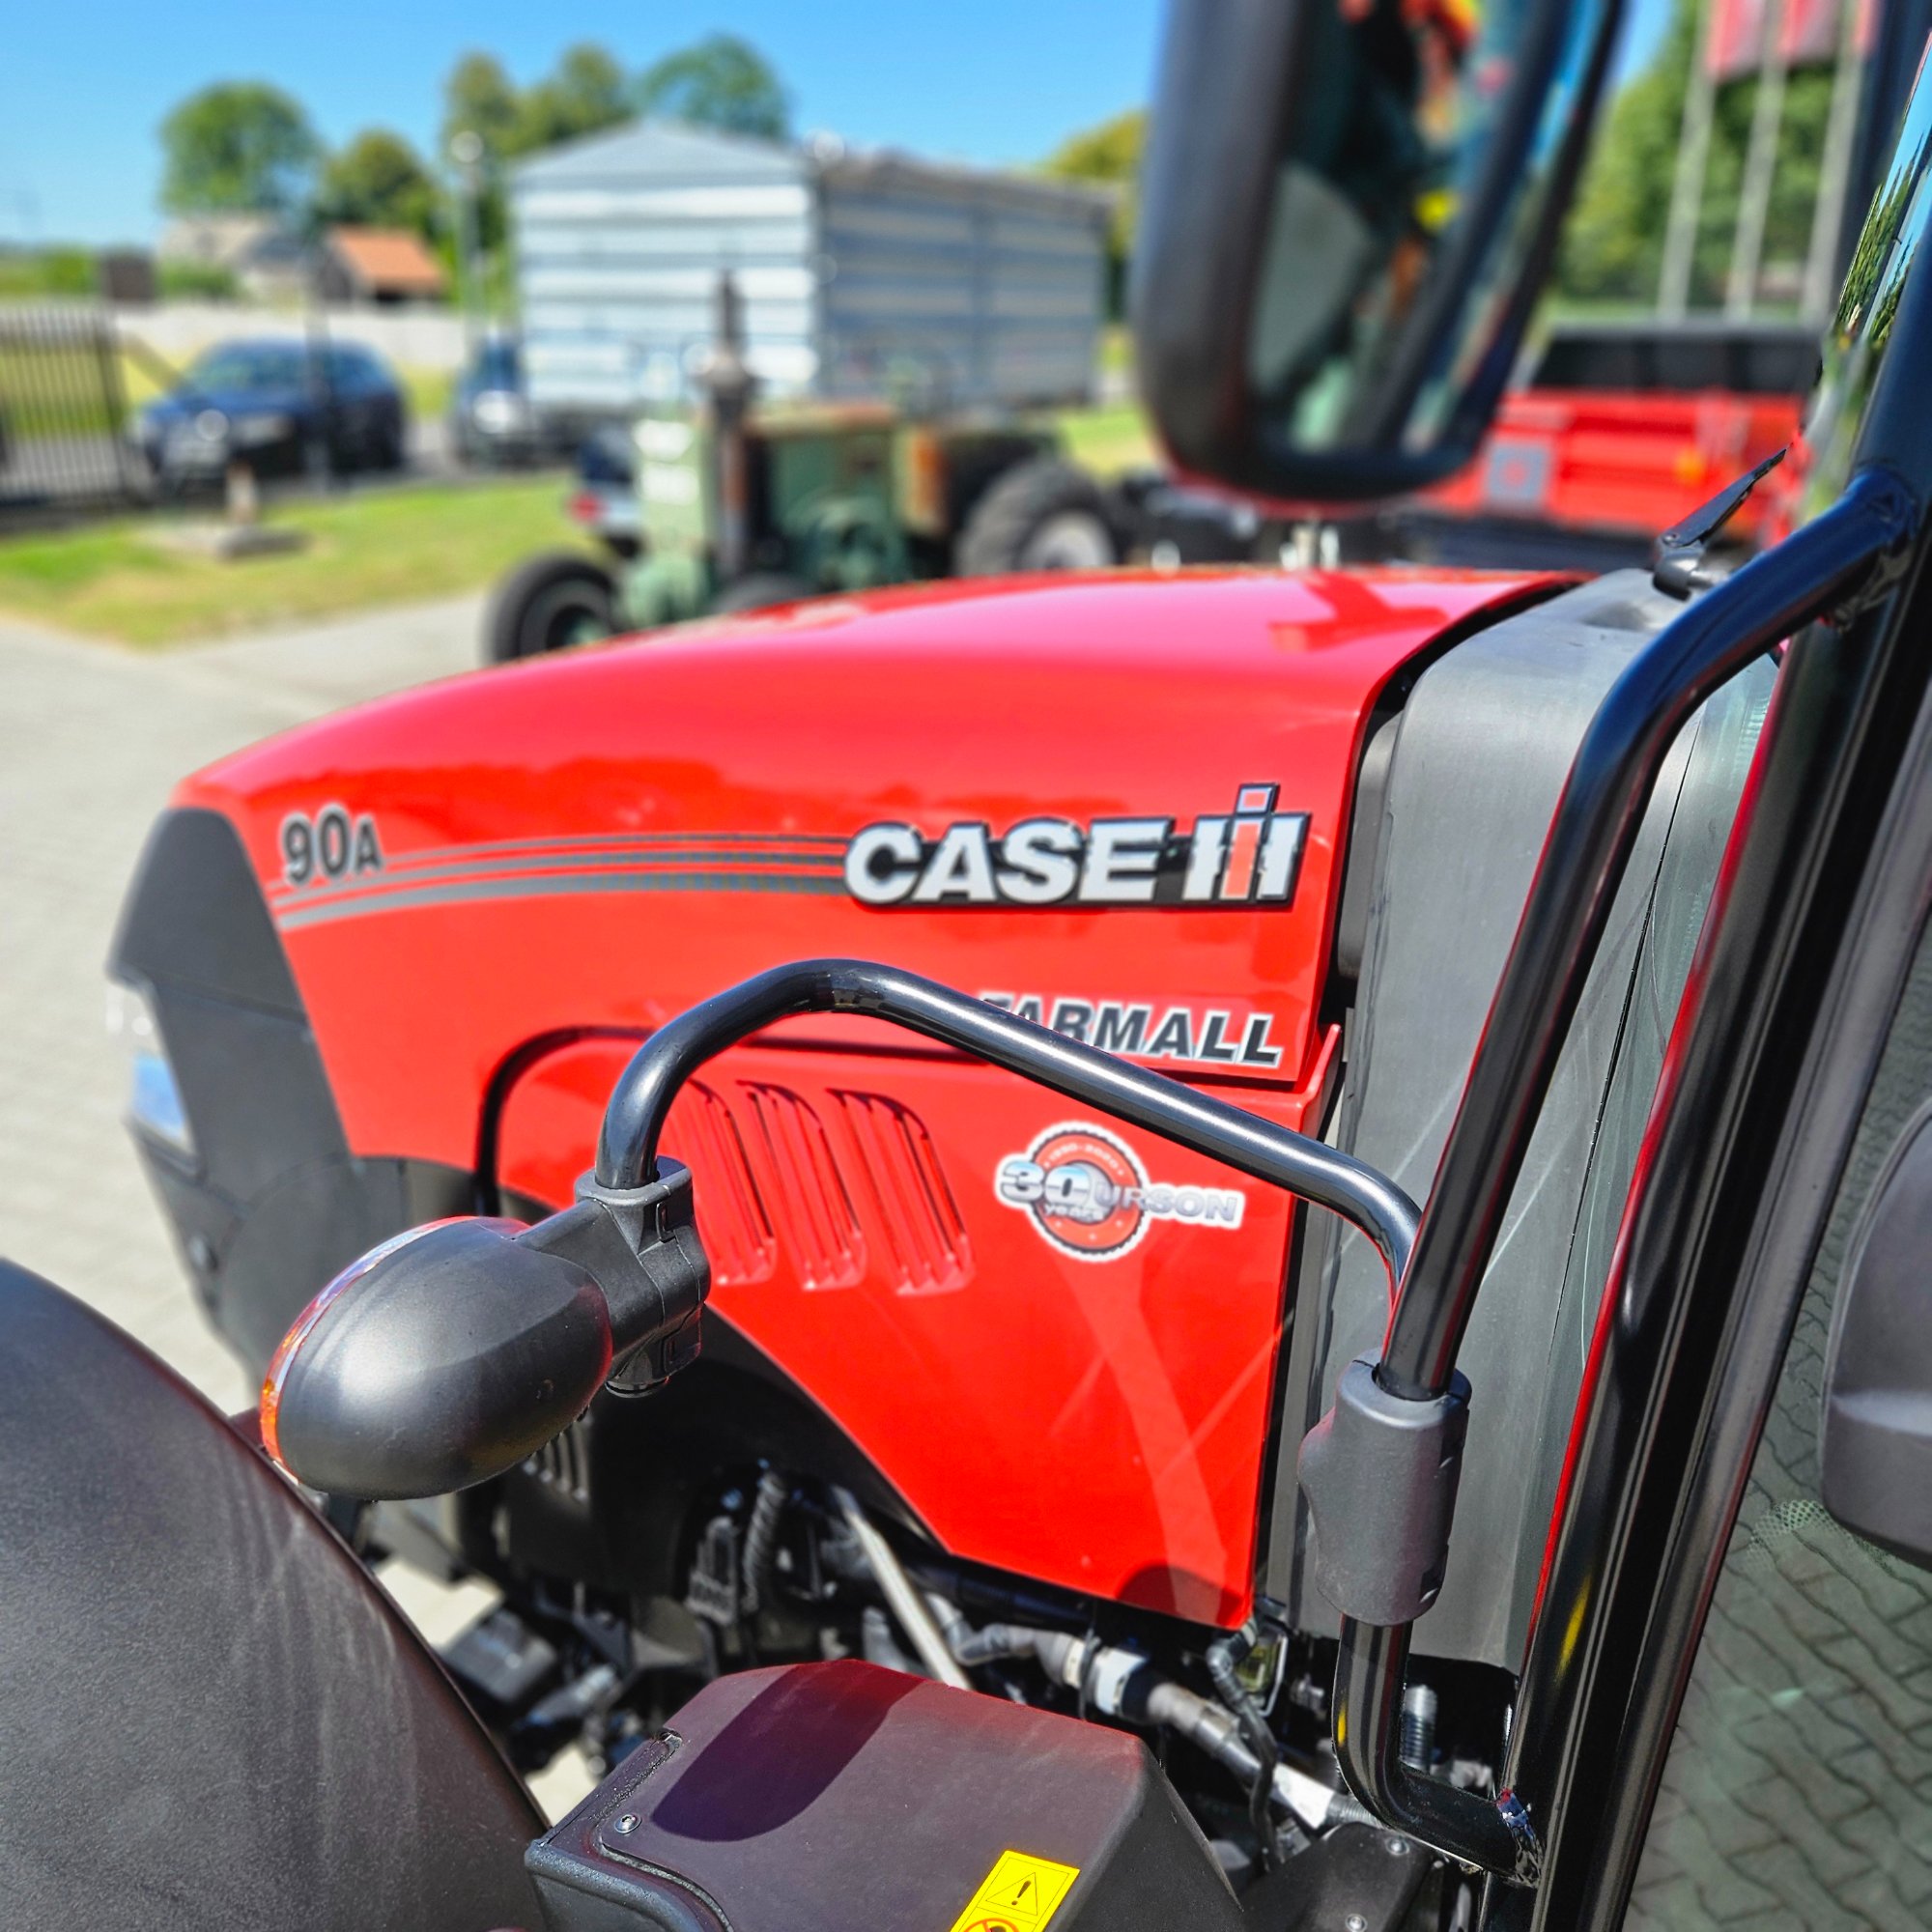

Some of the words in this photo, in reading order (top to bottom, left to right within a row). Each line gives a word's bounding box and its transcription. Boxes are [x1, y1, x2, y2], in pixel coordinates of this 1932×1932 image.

[281, 803, 384, 886] 90A
[844, 817, 1176, 905] CASE
[980, 992, 1284, 1066] RMALL
